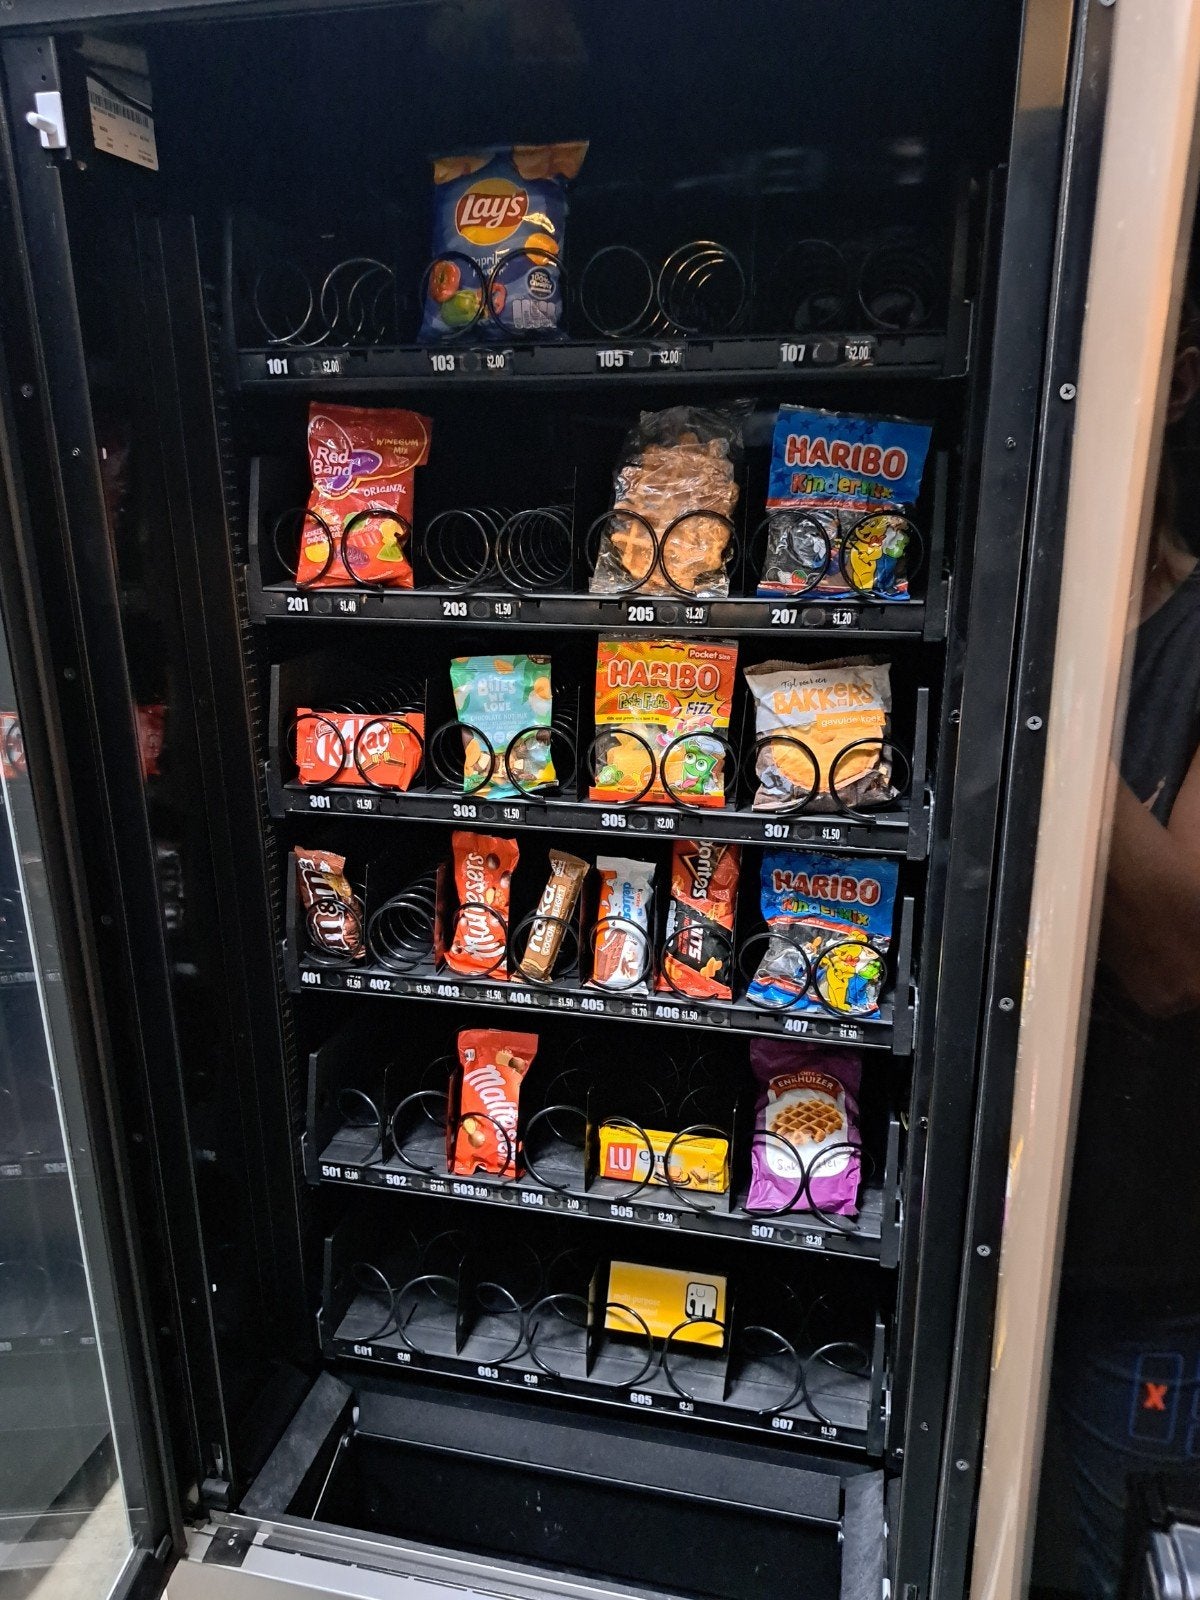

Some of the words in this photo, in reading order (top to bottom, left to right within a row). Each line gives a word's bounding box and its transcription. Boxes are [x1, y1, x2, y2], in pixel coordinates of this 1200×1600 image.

[460, 193, 525, 229] Lay's
[599, 351, 624, 368] 105
[780, 344, 806, 362] 107
[267, 358, 288, 375] 101
[322, 360, 340, 373] $2.00
[430, 355, 455, 371] 103
[486, 354, 505, 369] $2.00
[376, 438, 419, 447] WINEGUM
[316, 446, 349, 466] Red
[785, 434, 908, 481] HARIBO
[313, 460, 351, 476] Band
[363, 483, 407, 497] ORIGINAL
[287, 597, 309, 612] 201
[340, 600, 356, 613] $1.40
[443, 602, 468, 616] 203
[495, 602, 512, 616] $1.50
[628, 606, 654, 622] 205
[685, 607, 704, 620] $1.20
[771, 609, 797, 624] 207
[832, 612, 852, 625] $1.20
[689, 649, 717, 660] Pocket
[607, 659, 720, 693] HARIBO
[324, 719, 388, 768] KtKat
[309, 795, 331, 809] 301
[356, 798, 372, 810] $1.50
[453, 804, 477, 818] 303
[504, 808, 520, 820] $1.50
[601, 813, 626, 828] 305
[656, 817, 674, 830] $2.00
[764, 824, 790, 838] 307
[822, 828, 840, 841] $1.50
[772, 868, 881, 907] HARIBO
[301, 971, 321, 984] 401
[370, 979, 391, 990] 402
[416, 985, 431, 995] $1.50
[437, 985, 460, 998] 403
[486, 989, 501, 1000] $1.50
[509, 991, 532, 1004] 404
[581, 999, 604, 1011] 405
[656, 1006, 680, 1020] 406
[682, 1009, 697, 1021] $1.50
[785, 1019, 809, 1033] 407
[778, 1074, 834, 1090] ENKHUIZER
[464, 1064, 518, 1161] Maltese
[609, 1146, 632, 1171] LU
[322, 1165, 341, 1178] 501
[386, 1174, 407, 1187] 502
[453, 1183, 474, 1196] 503
[521, 1192, 544, 1205] 504
[610, 1204, 633, 1218] 505
[751, 1225, 774, 1239] 507
[354, 1344, 373, 1357] 601
[477, 1366, 499, 1378] 603
[630, 1392, 652, 1406] 605
[771, 1417, 794, 1430] 607
